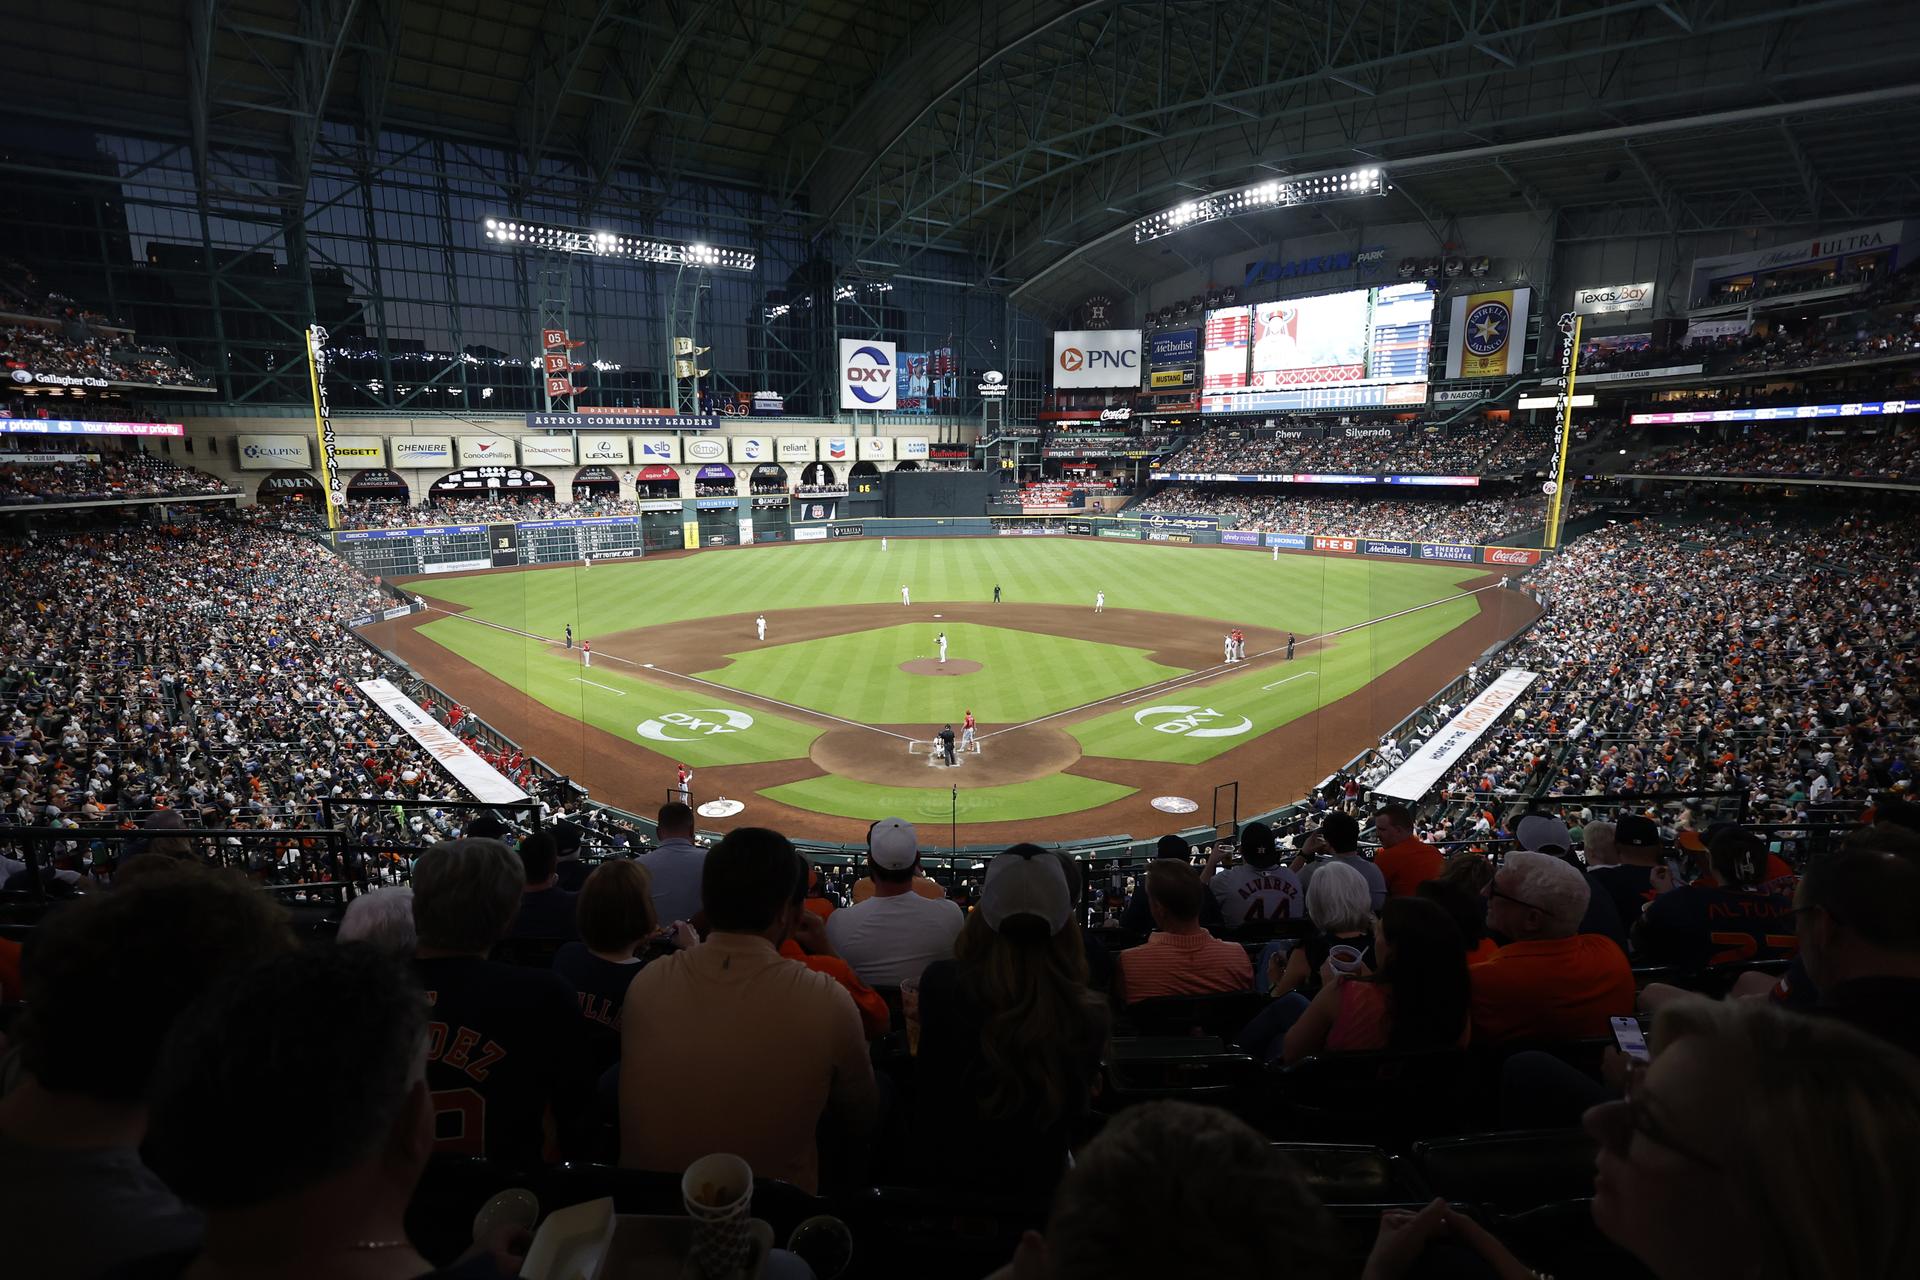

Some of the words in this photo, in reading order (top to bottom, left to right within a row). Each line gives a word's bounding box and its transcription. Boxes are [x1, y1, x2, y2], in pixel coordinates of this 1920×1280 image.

[1823, 232, 1883, 255] ULTRA
[1265, 252, 1350, 281] DAIKIN
[1357, 250, 1385, 262] PARK
[1581, 291, 1615, 304] Texas
[1620, 287, 1648, 300] Bay
[1471, 307, 1507, 324] ESTRELLA
[548, 333, 562, 343] 05
[1154, 341, 1193, 354] Methodist
[1471, 339, 1502, 352] JALISCO
[551, 358, 563, 368] 19
[1087, 350, 1137, 369] PNC
[35, 373, 83, 386] Gallagher
[84, 377, 109, 387] Club
[847, 367, 892, 383] OXY
[1155, 374, 1181, 382] MUSTANG
[552, 382, 564, 390] 21
[977, 383, 1009, 391] Gallagher
[1451, 391, 1482, 400] NABORS
[1100, 408, 1132, 421] Coca-Cola
[535, 416, 583, 425] ASTROS
[587, 416, 660, 425] COMMUNITY
[665, 418, 713, 427] LEADERS
[10, 420, 48, 433] priority
[81, 421, 103, 432] Your
[105, 422, 133, 435] vision,
[134, 424, 147, 433] our
[149, 423, 178, 435] priority
[1275, 430, 1302, 440] Chevy
[1345, 428, 1391, 438] Silverado
[397, 444, 447, 452] CHENIERE
[654, 441, 671, 451] slb
[783, 444, 807, 452] reliant
[260, 448, 303, 456] CALPINE
[334, 448, 379, 456] OGGETT
[463, 451, 512, 460] ConocoPhillips
[1048, 450, 1075, 458] impact
[270, 478, 314, 489] MAVEN
[1274, 537, 1305, 545] HONDA
[1368, 544, 1408, 555] Methodist
[1435, 545, 1465, 553] ENERGY
[1435, 551, 1472, 560] TRANSFER
[1491, 550, 1532, 563] Coca-Cola
[658, 712, 738, 736] OXY
[1152, 708, 1226, 734] OXY
[1237, 876, 1299, 900] ALVAREZ
[1244, 896, 1291, 921] 44
